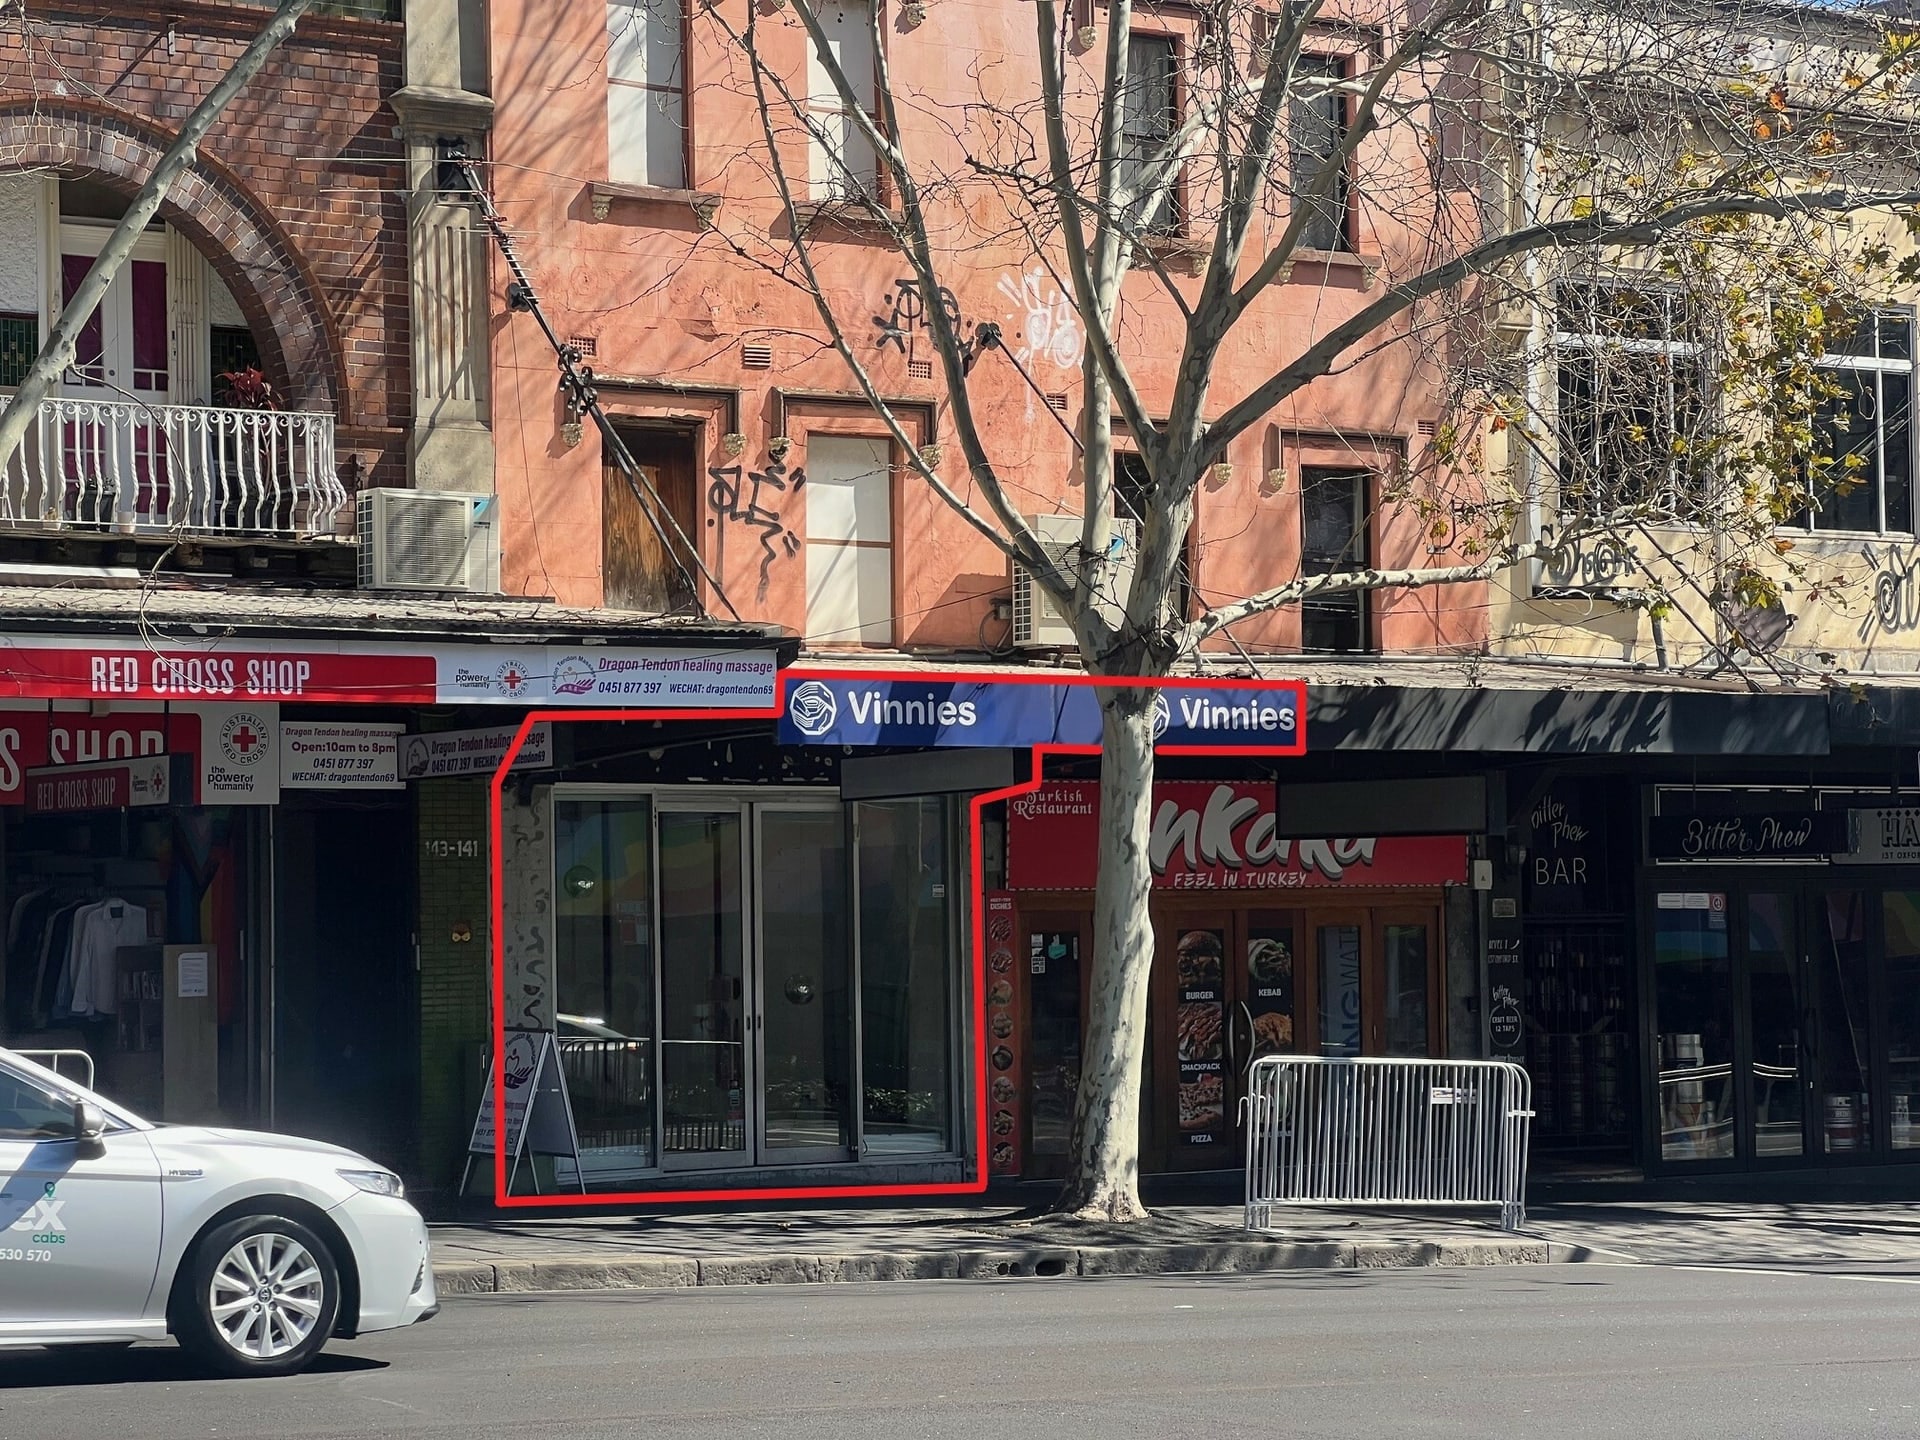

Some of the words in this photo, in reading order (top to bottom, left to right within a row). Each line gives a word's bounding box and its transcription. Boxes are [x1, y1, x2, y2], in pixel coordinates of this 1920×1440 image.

[599, 657, 639, 673] Dragon
[641, 658, 681, 671] Tendon
[682, 658, 723, 675] healing
[725, 661, 773, 676] massage
[91, 656, 139, 693] RED
[152, 657, 234, 695] CROSS
[247, 659, 310, 695] SHOP
[598, 681, 622, 694] 0451
[623, 682, 642, 694] 877
[643, 682, 662, 694] 397
[669, 683, 705, 694] WECHAT:
[706, 683, 774, 696] dragontendon69
[848, 690, 977, 726] Vinnies
[1180, 698, 1295, 731] Vinnies
[222, 714, 267, 739] AUSTRALIAN
[285, 727, 312, 738] Dragon
[314, 727, 340, 737] Tendon
[341, 728, 369, 739] healing
[369, 731, 400, 740] massag
[222, 742, 236, 760] RED
[240, 743, 267, 764] CROSS
[358, 743, 370, 753] to
[371, 742, 396, 755] 8pm
[431, 740, 457, 757] Dragon
[457, 737, 483, 752] Tendon
[483, 734, 511, 751] healing
[211, 765, 225, 774] the
[313, 757, 336, 769] 0451
[337, 758, 356, 769] 877
[356, 758, 375, 769] 397
[431, 760, 446, 773] 0451
[459, 757, 471, 770] 397
[292, 771, 327, 781] WECHAT:
[328, 772, 395, 784] dragontendon69
[37, 782, 54, 811] RED
[57, 779, 88, 809] CROSS
[92, 776, 116, 806] SHOP
[213, 782, 254, 792] humanity
[1026, 789, 1082, 805] Turkish
[1013, 800, 1092, 820] Restaurant
[1681, 817, 1753, 855] Bitter
[1754, 817, 1812, 852] Phew
[1174, 872, 1216, 887] FEEL
[1245, 871, 1307, 887] TURKEY
[1535, 857, 1587, 885] BAR
[1185, 991, 1214, 1000] BURGER
[1258, 988, 1282, 997] KEBAB
[1191, 1134, 1213, 1143] PIZZA
[32, 1231, 66, 1244] cabs
[26, 1249, 52, 1262] 570
